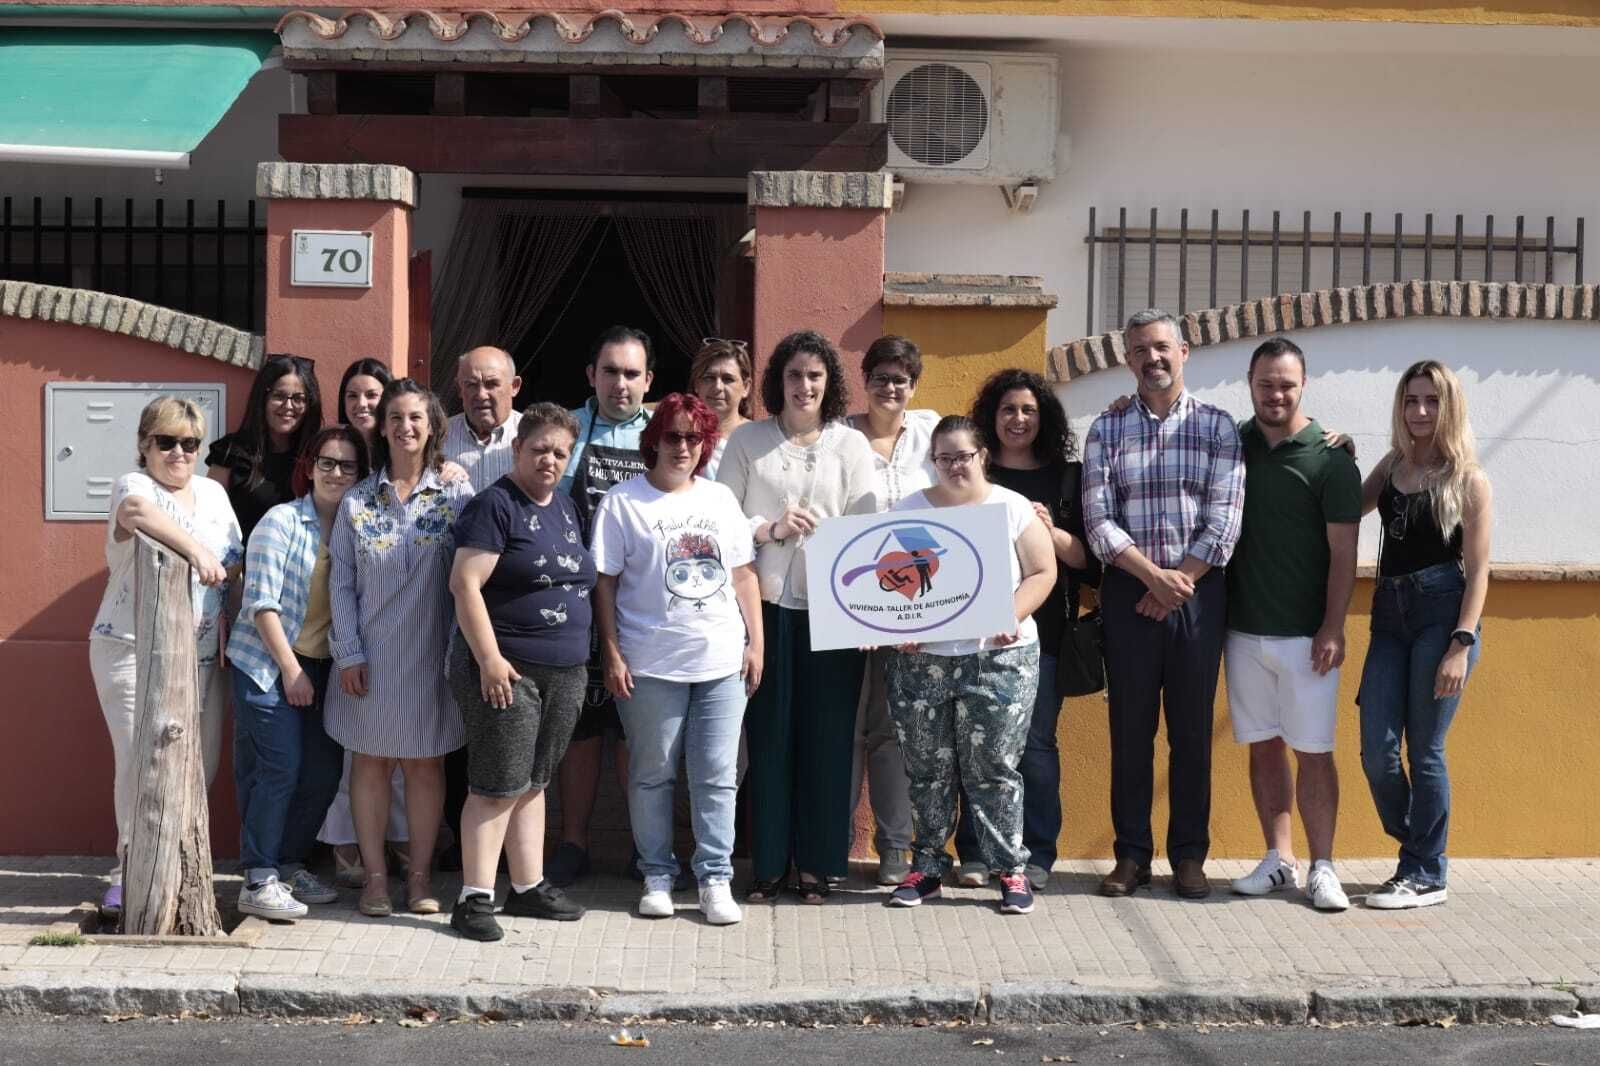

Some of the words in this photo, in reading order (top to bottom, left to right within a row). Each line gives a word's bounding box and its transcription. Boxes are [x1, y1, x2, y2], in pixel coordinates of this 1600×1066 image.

[321, 248, 362, 273] 70
[849, 603, 884, 612] VIVIENDA
[886, 604, 912, 612] TALLER
[925, 592, 970, 609] AUTONOMÍA
